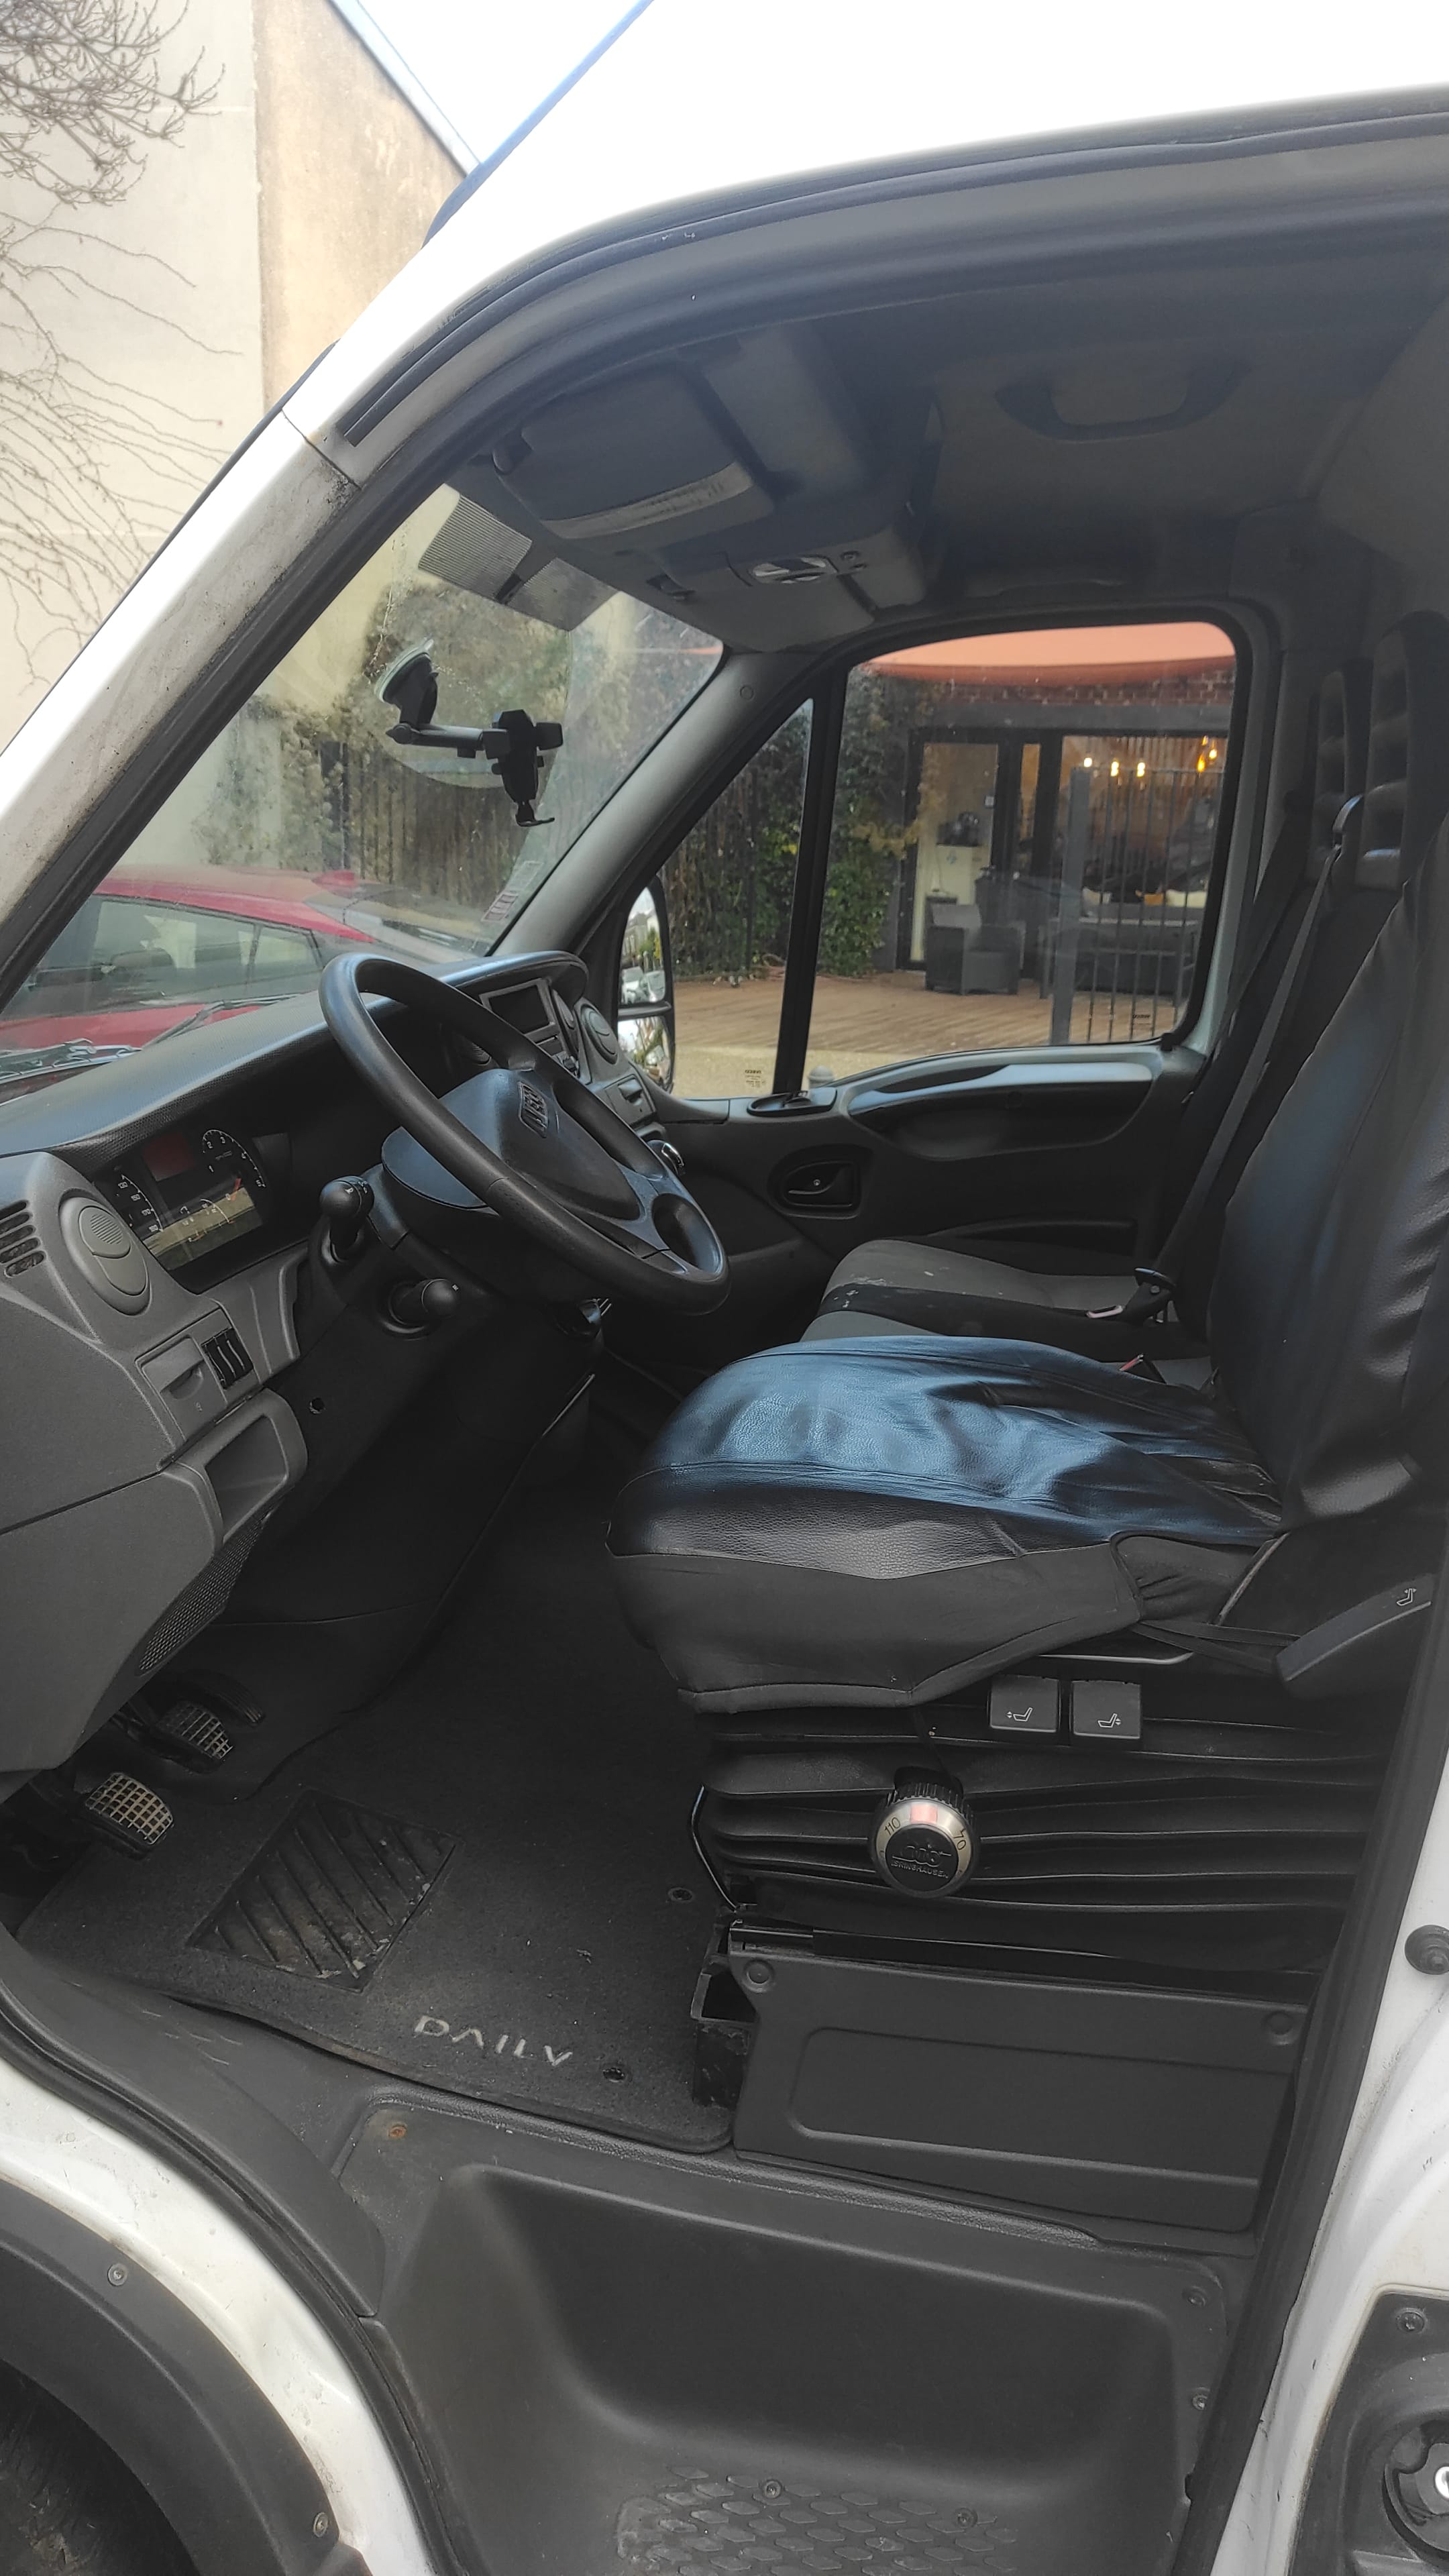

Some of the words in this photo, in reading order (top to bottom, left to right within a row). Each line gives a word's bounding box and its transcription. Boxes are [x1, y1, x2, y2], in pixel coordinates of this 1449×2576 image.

[207, 1141, 213, 1149] 2
[883, 1817, 901, 1835] 110
[953, 1828, 967, 1850] 70
[414, 2015, 573, 2066] DAILY
